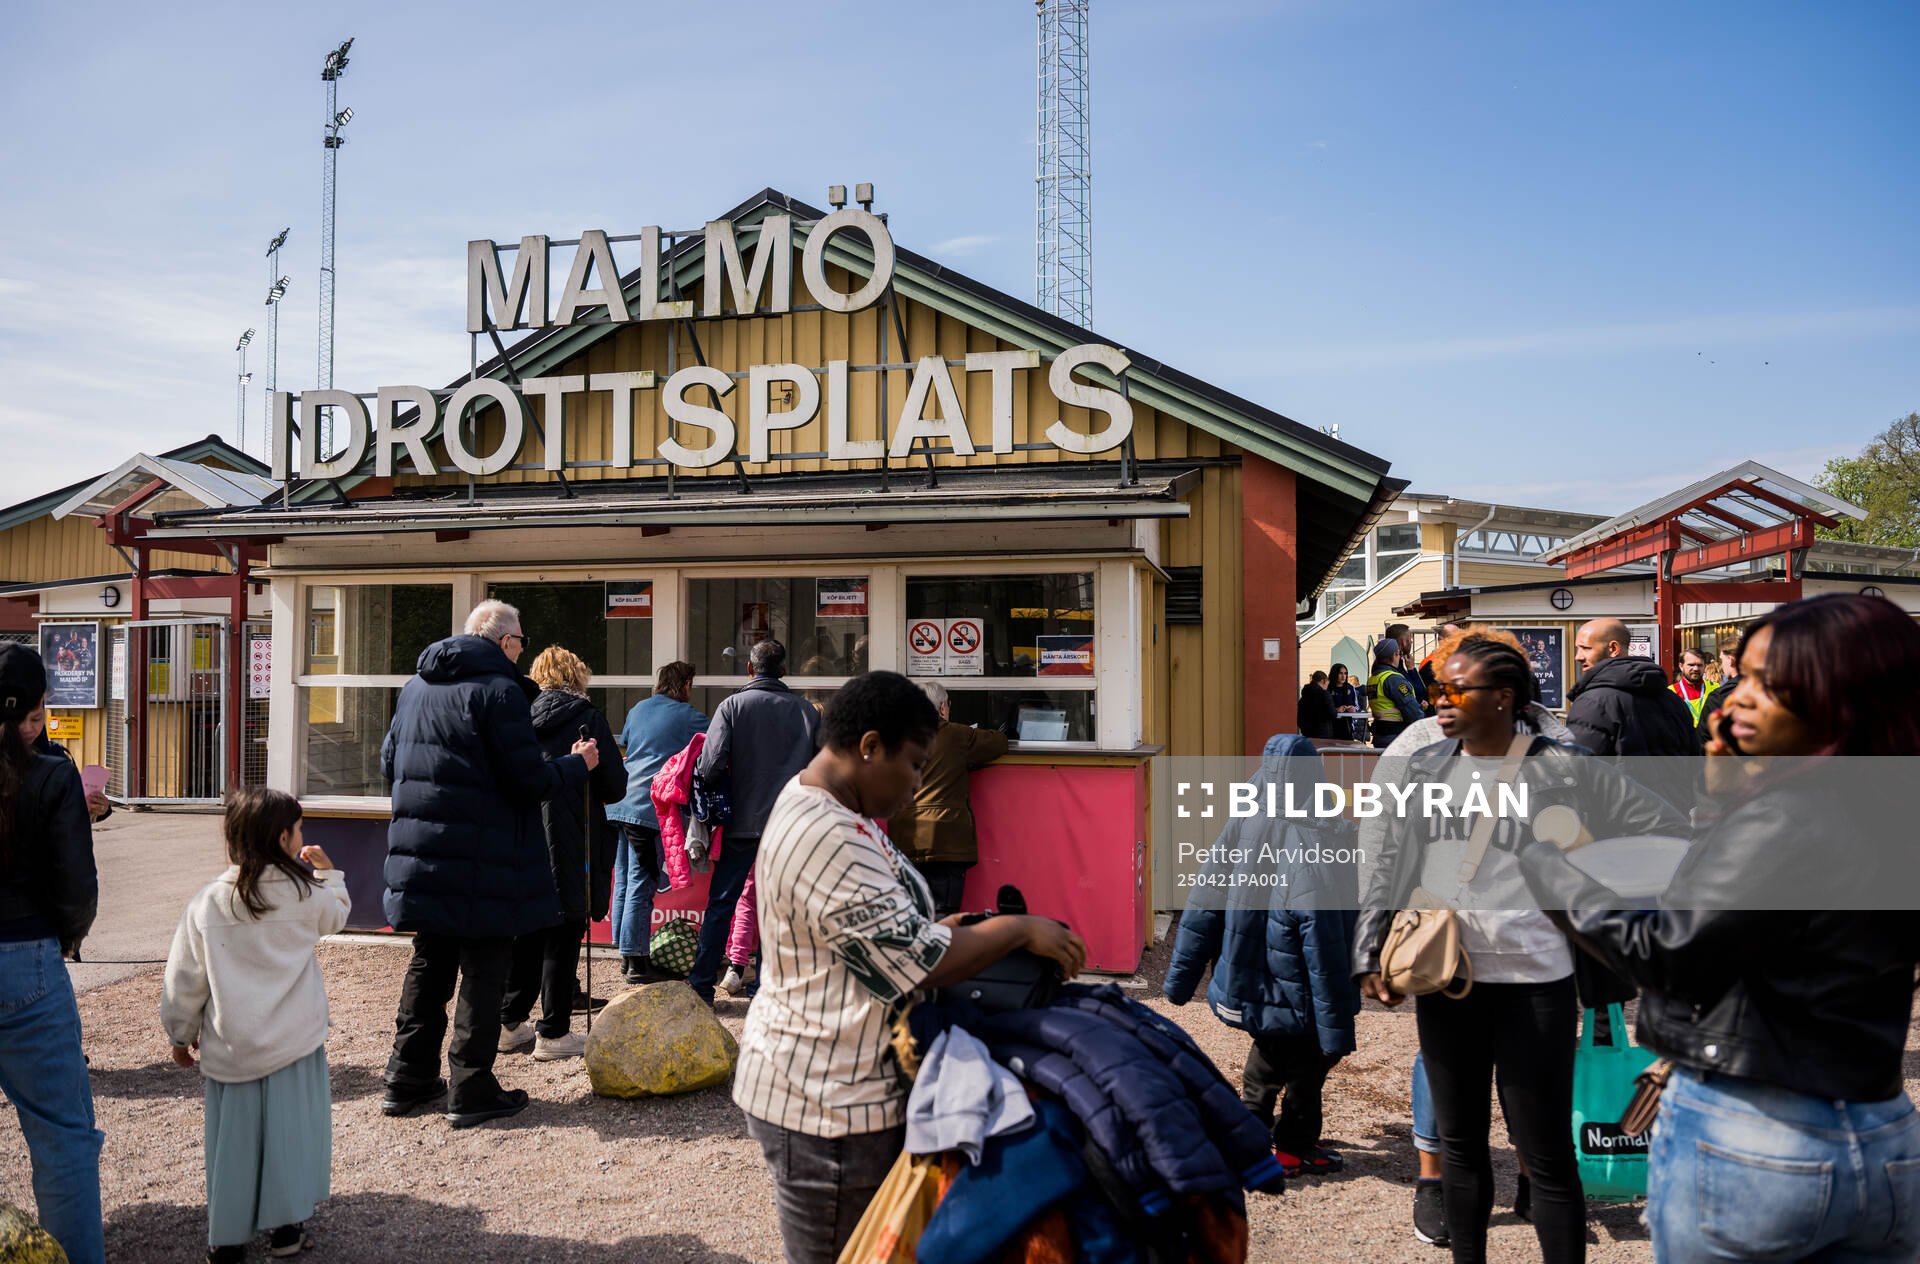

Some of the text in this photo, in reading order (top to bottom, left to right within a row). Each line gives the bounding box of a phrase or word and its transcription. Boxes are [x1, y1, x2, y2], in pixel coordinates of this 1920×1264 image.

[467, 183, 896, 333] MALMÖ
[271, 343, 1134, 481] IDROTTSPLATS
[1063, 652, 1088, 660] ÅRSKORT
[1544, 670, 1555, 679] PÅ
[834, 896, 898, 930] LEGEND
[1587, 1127, 1650, 1148] Normal
